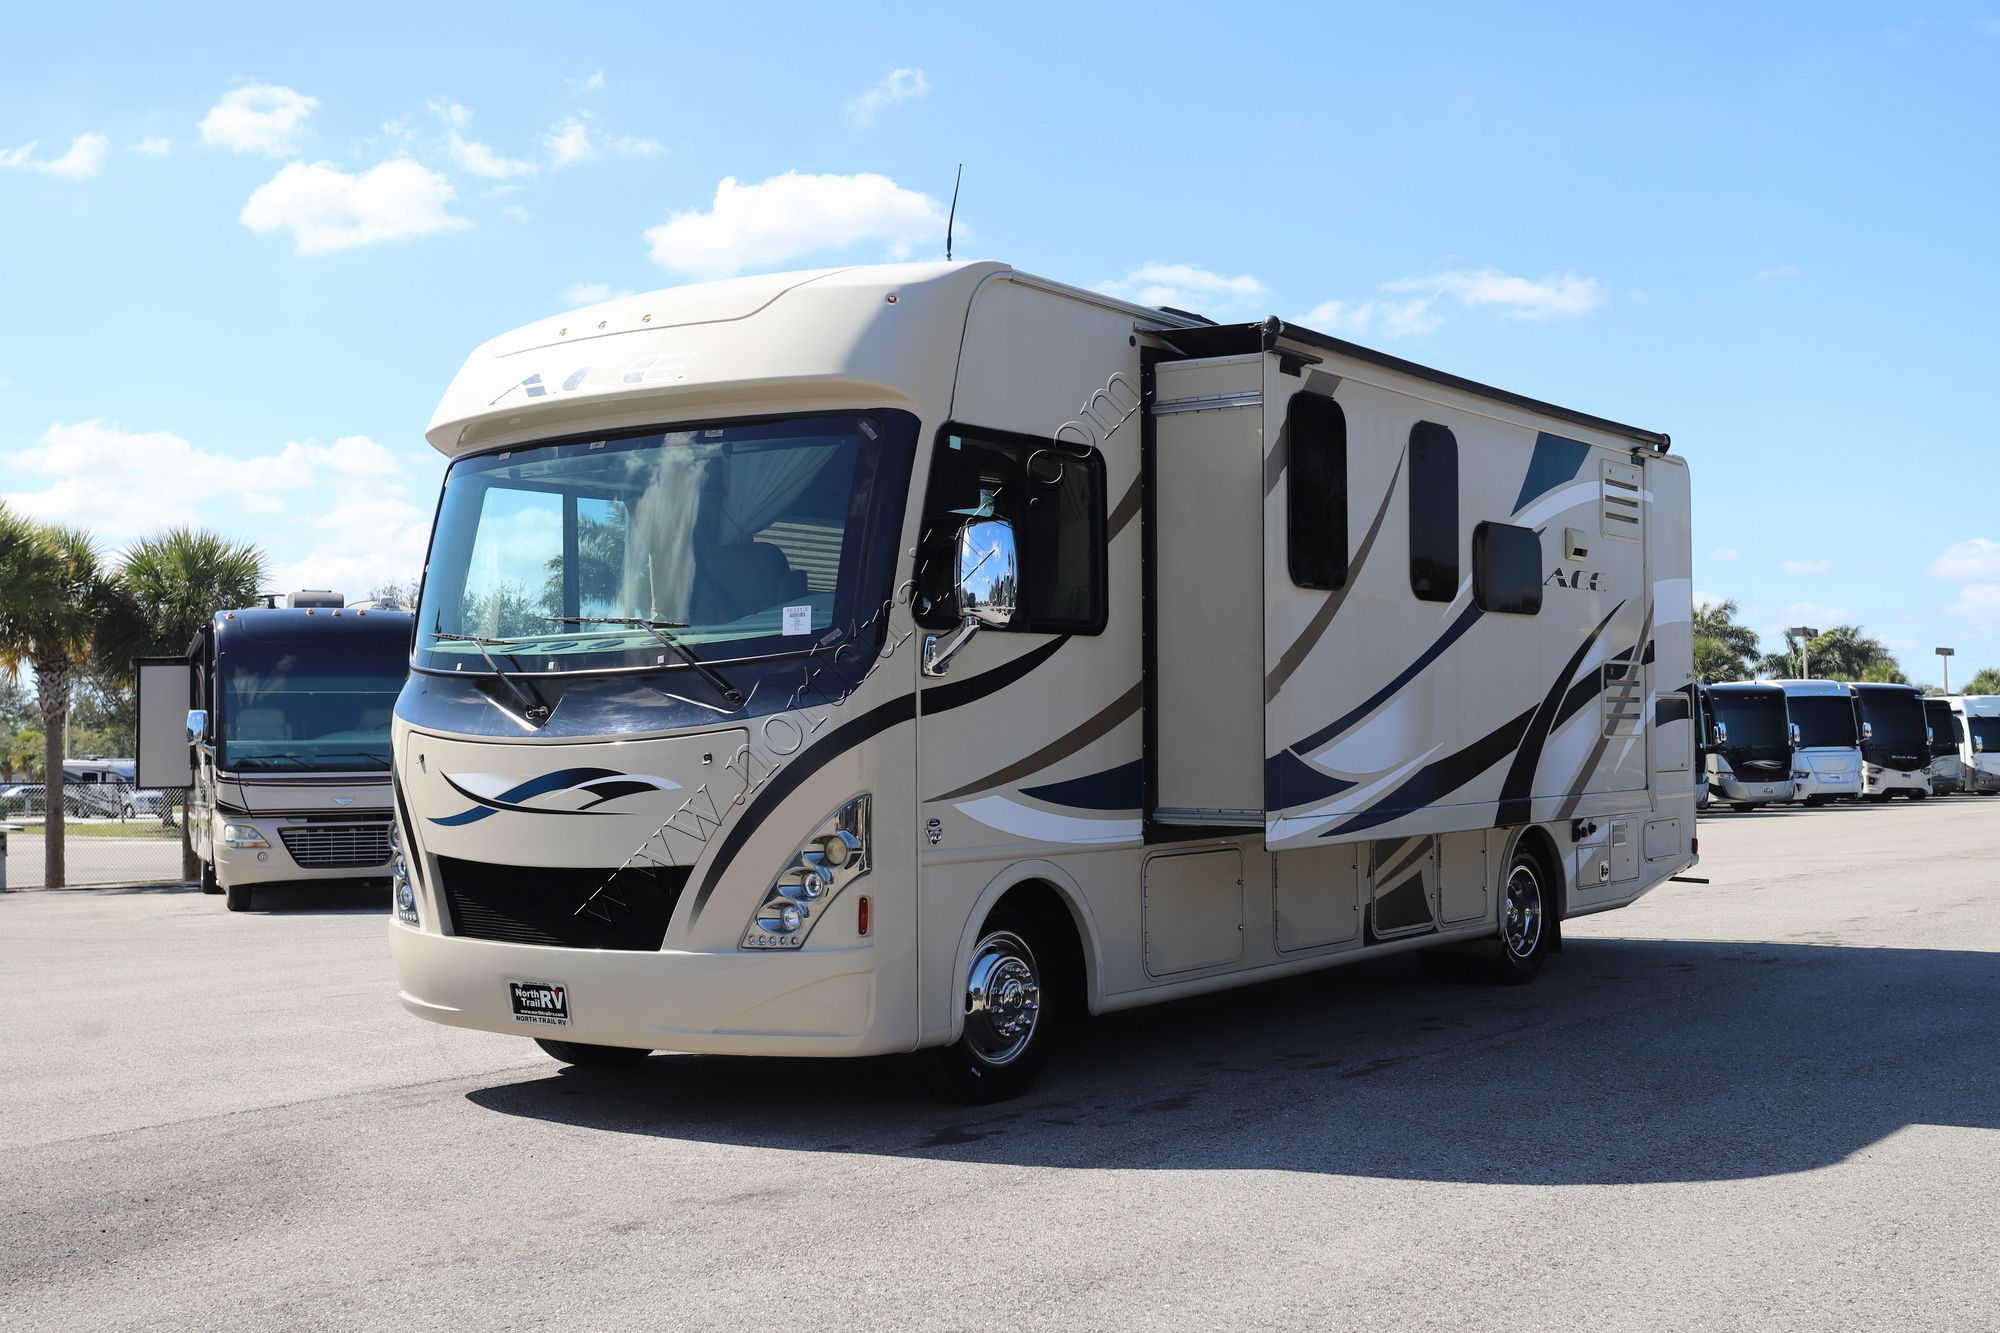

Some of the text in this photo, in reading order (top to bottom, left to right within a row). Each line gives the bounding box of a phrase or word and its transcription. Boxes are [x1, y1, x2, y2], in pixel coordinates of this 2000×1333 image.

[515, 988, 539, 998] North
[520, 998, 540, 1007] Trail
[540, 990, 563, 1009] RV
[539, 1017, 557, 1025] TRAIL
